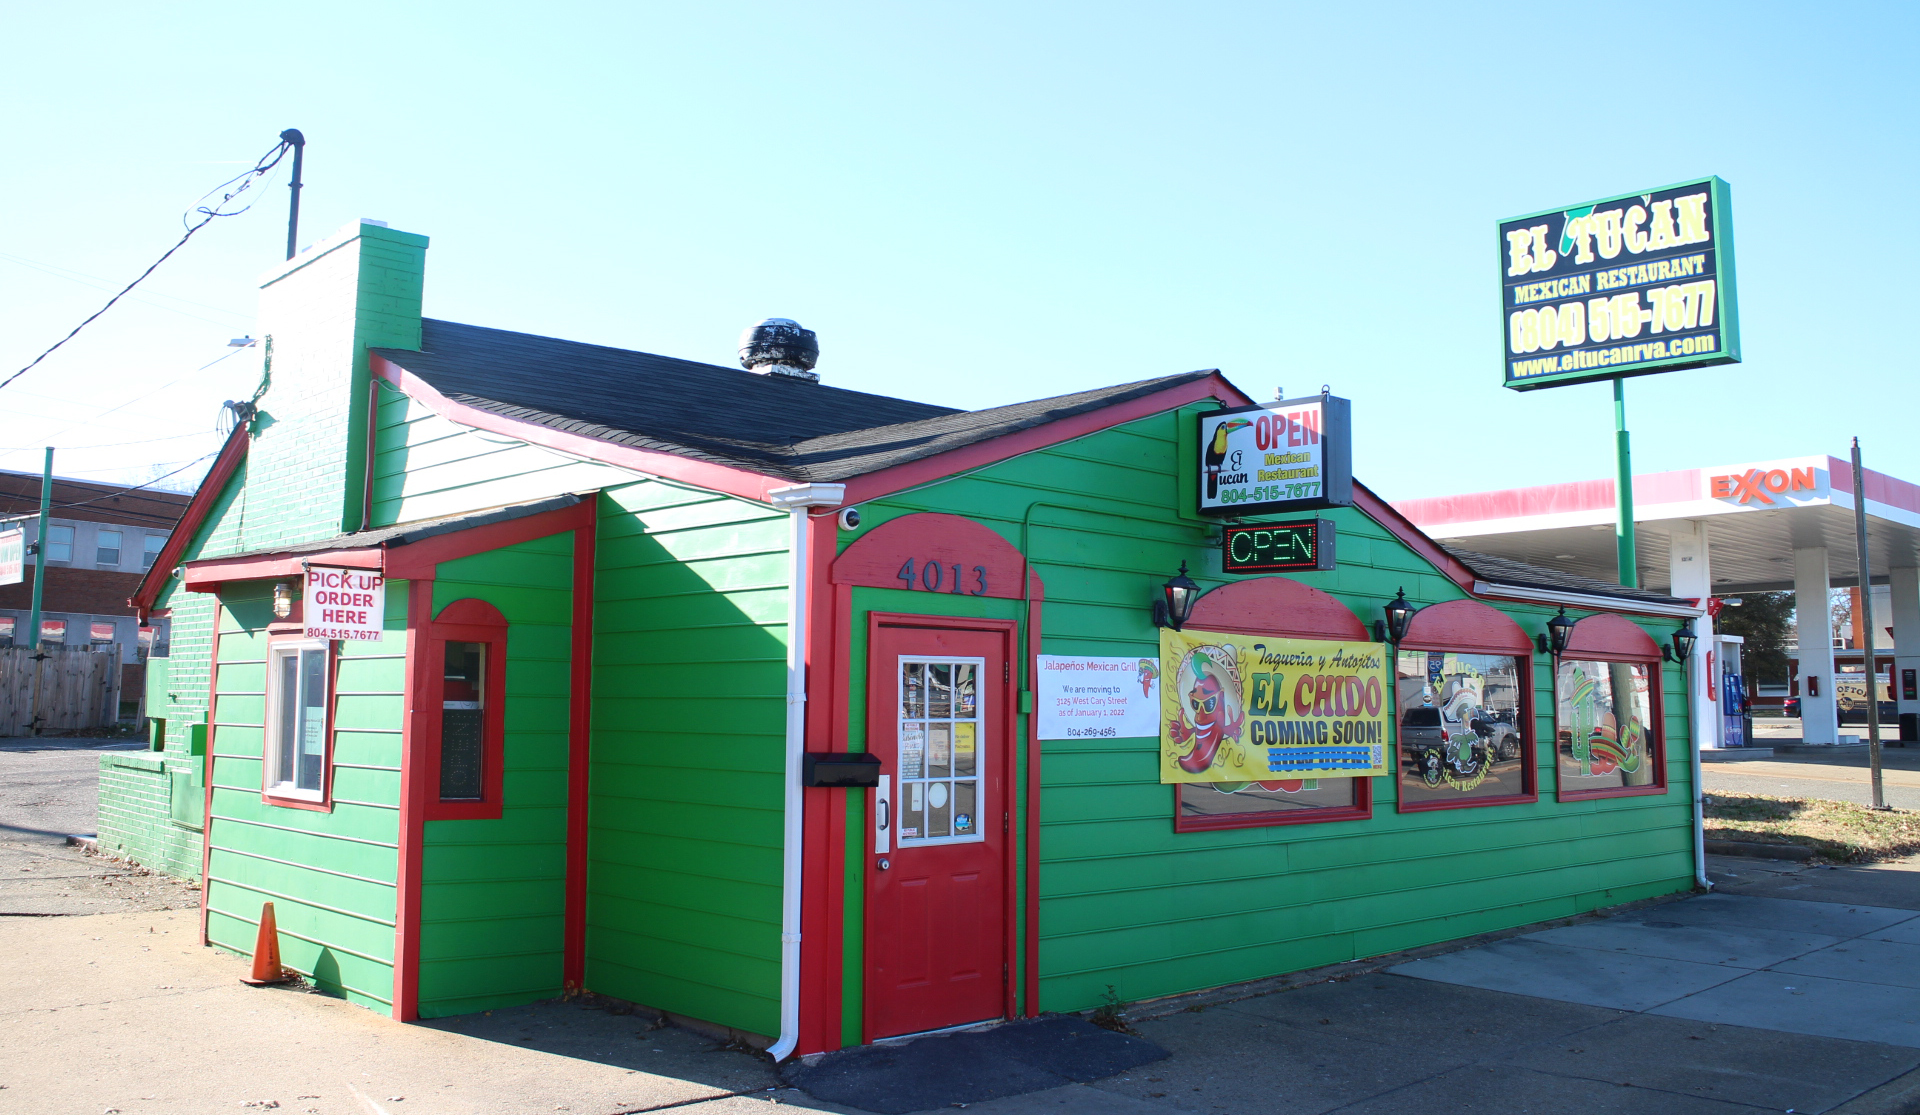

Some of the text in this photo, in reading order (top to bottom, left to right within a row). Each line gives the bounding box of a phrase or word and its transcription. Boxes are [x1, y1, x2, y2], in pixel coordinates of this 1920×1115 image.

[1507, 224, 1557, 277] EL
[1514, 254, 1706, 305] MEXICAN RESTAURANT
[1510, 280, 1715, 354] (804) 515-7677
[1512, 334, 1715, 378] www.eltucanrva.com
[1256, 410, 1319, 451] OPEN
[1264, 452, 1311, 466] Mexican
[1257, 465, 1319, 482] Restaurant
[1221, 482, 1321, 503] 804-515-7677
[1710, 466, 1816, 504] EXXON
[1231, 528, 1312, 562] OPEN
[308, 572, 384, 591] PICK UP
[897, 557, 988, 596] 4013
[315, 591, 374, 607] ORDER
[322, 609, 367, 624] HERE
[307, 627, 379, 640] 804.515.7677
[1044, 661, 1137, 673] Jalapeños Mexican Grill
[1319, 655, 1327, 672] y
[1329, 649, 1381, 673] Antojitos
[1433, 660, 1485, 694] El Tucan
[1062, 685, 1074, 693] We
[1087, 685, 1112, 695] moving
[1248, 672, 1382, 718] EL CHIDO
[1056, 697, 1128, 707] 3125 West Cary Street
[1074, 709, 1102, 718] January
[1067, 727, 1117, 737] 804-269-4565
[1250, 720, 1382, 745] COMING SOON!
